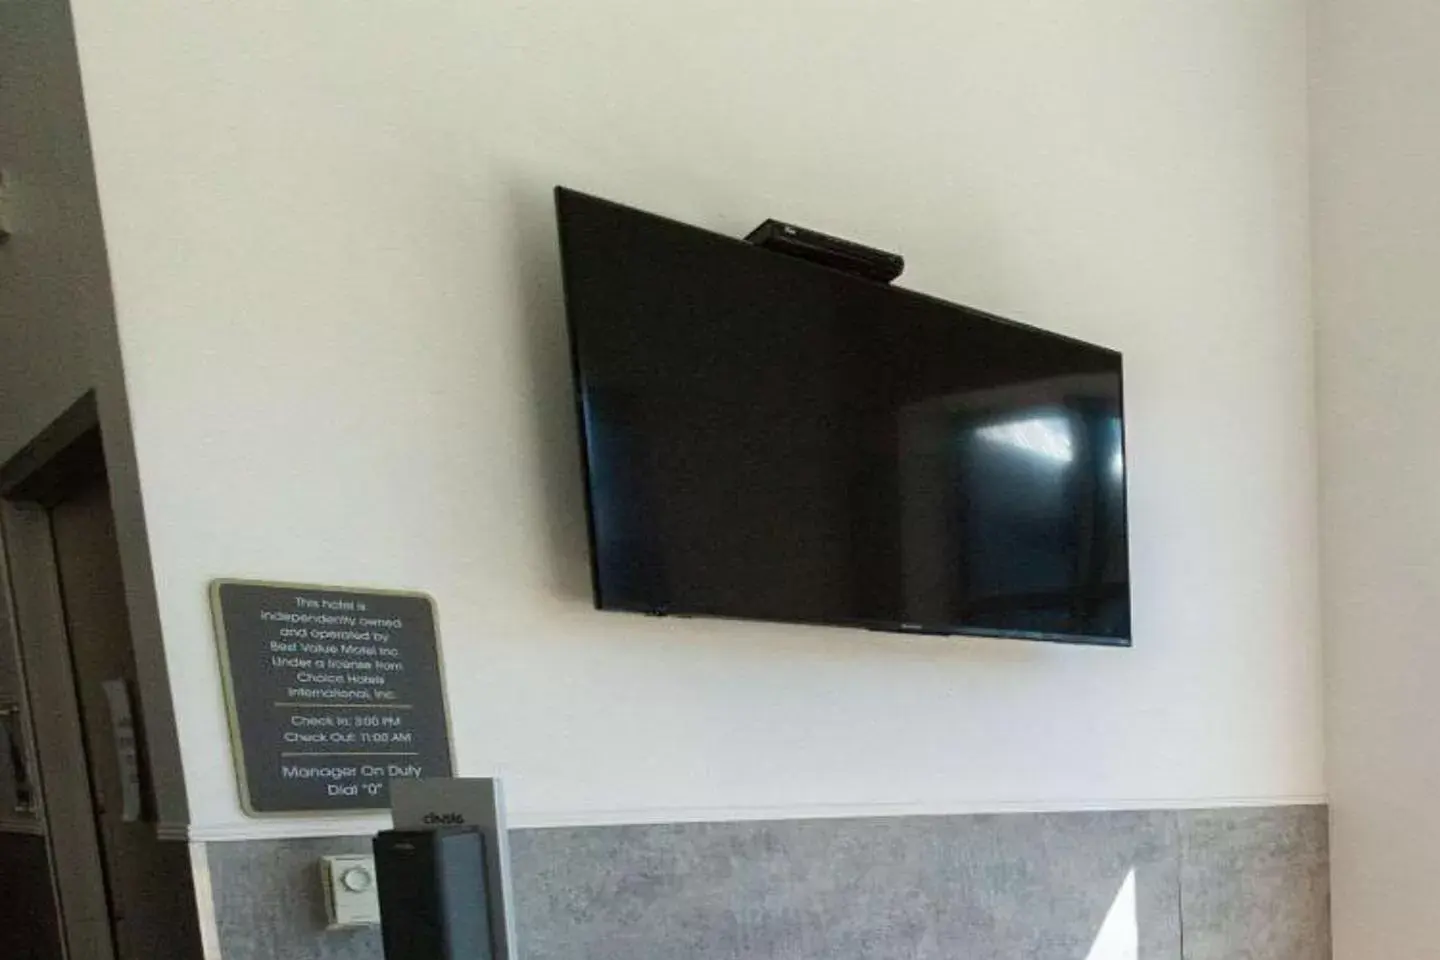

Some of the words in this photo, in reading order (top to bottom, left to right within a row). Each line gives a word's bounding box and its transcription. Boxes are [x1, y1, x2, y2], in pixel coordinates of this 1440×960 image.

[296, 597, 320, 608] This
[360, 616, 402, 628] owned
[280, 628, 307, 638] and
[310, 630, 370, 641] operated
[374, 632, 389, 642] by
[270, 641, 298, 652] Best
[301, 643, 336, 653] Value
[340, 645, 376, 656] Motel
[272, 656, 312, 668] Under
[316, 660, 324, 668] a
[328, 659, 372, 670] license
[376, 661, 402, 672] from
[296, 672, 344, 683] Choice
[348, 674, 385, 685] Hotels
[291, 715, 334, 726] Check
[382, 717, 401, 726] PM
[284, 732, 328, 742] Check
[361, 732, 389, 742] 11:00
[390, 732, 412, 743] AM
[282, 765, 356, 780] Manager
[360, 766, 385, 776] On
[388, 765, 422, 778] Duty
[328, 783, 358, 796] Dial
